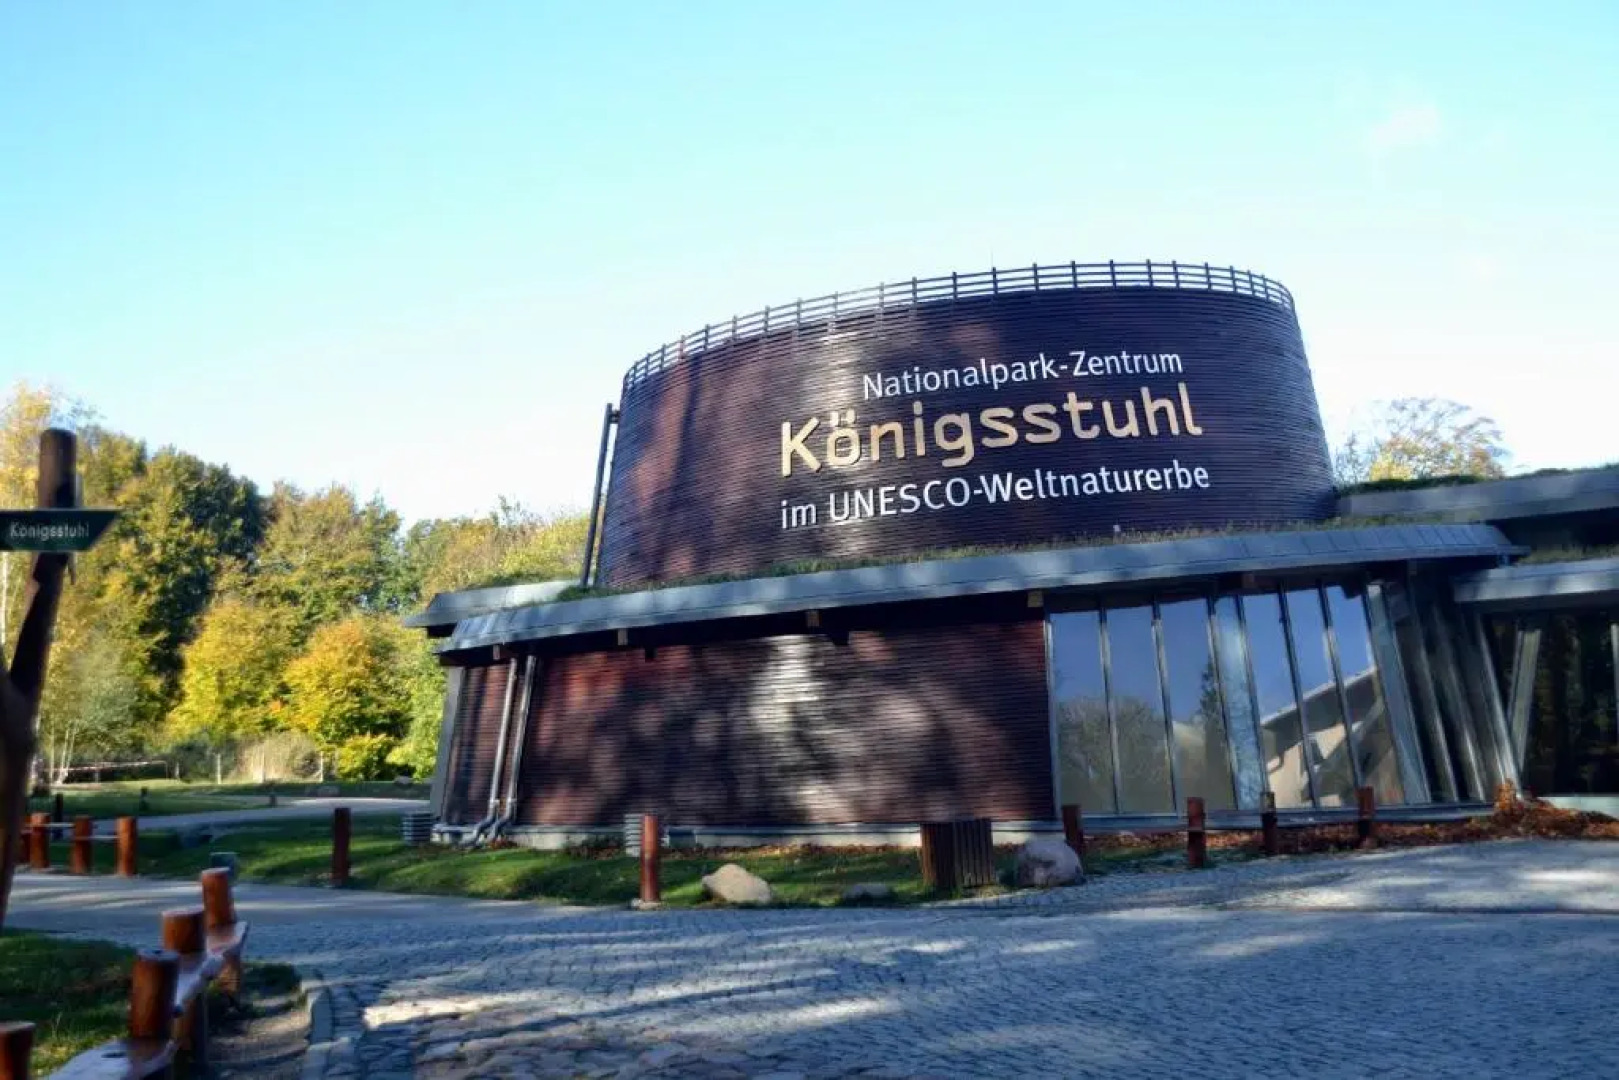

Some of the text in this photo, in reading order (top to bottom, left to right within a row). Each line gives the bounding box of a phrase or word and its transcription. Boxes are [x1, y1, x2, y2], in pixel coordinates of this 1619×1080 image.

[863, 351, 1183, 400] Nationalpark-Zentrum
[781, 382, 1203, 477] Königsstuhl
[781, 460, 1210, 529] im UNESCO-Weltnaturerbe
[10, 521, 90, 541] Königsstuhl
